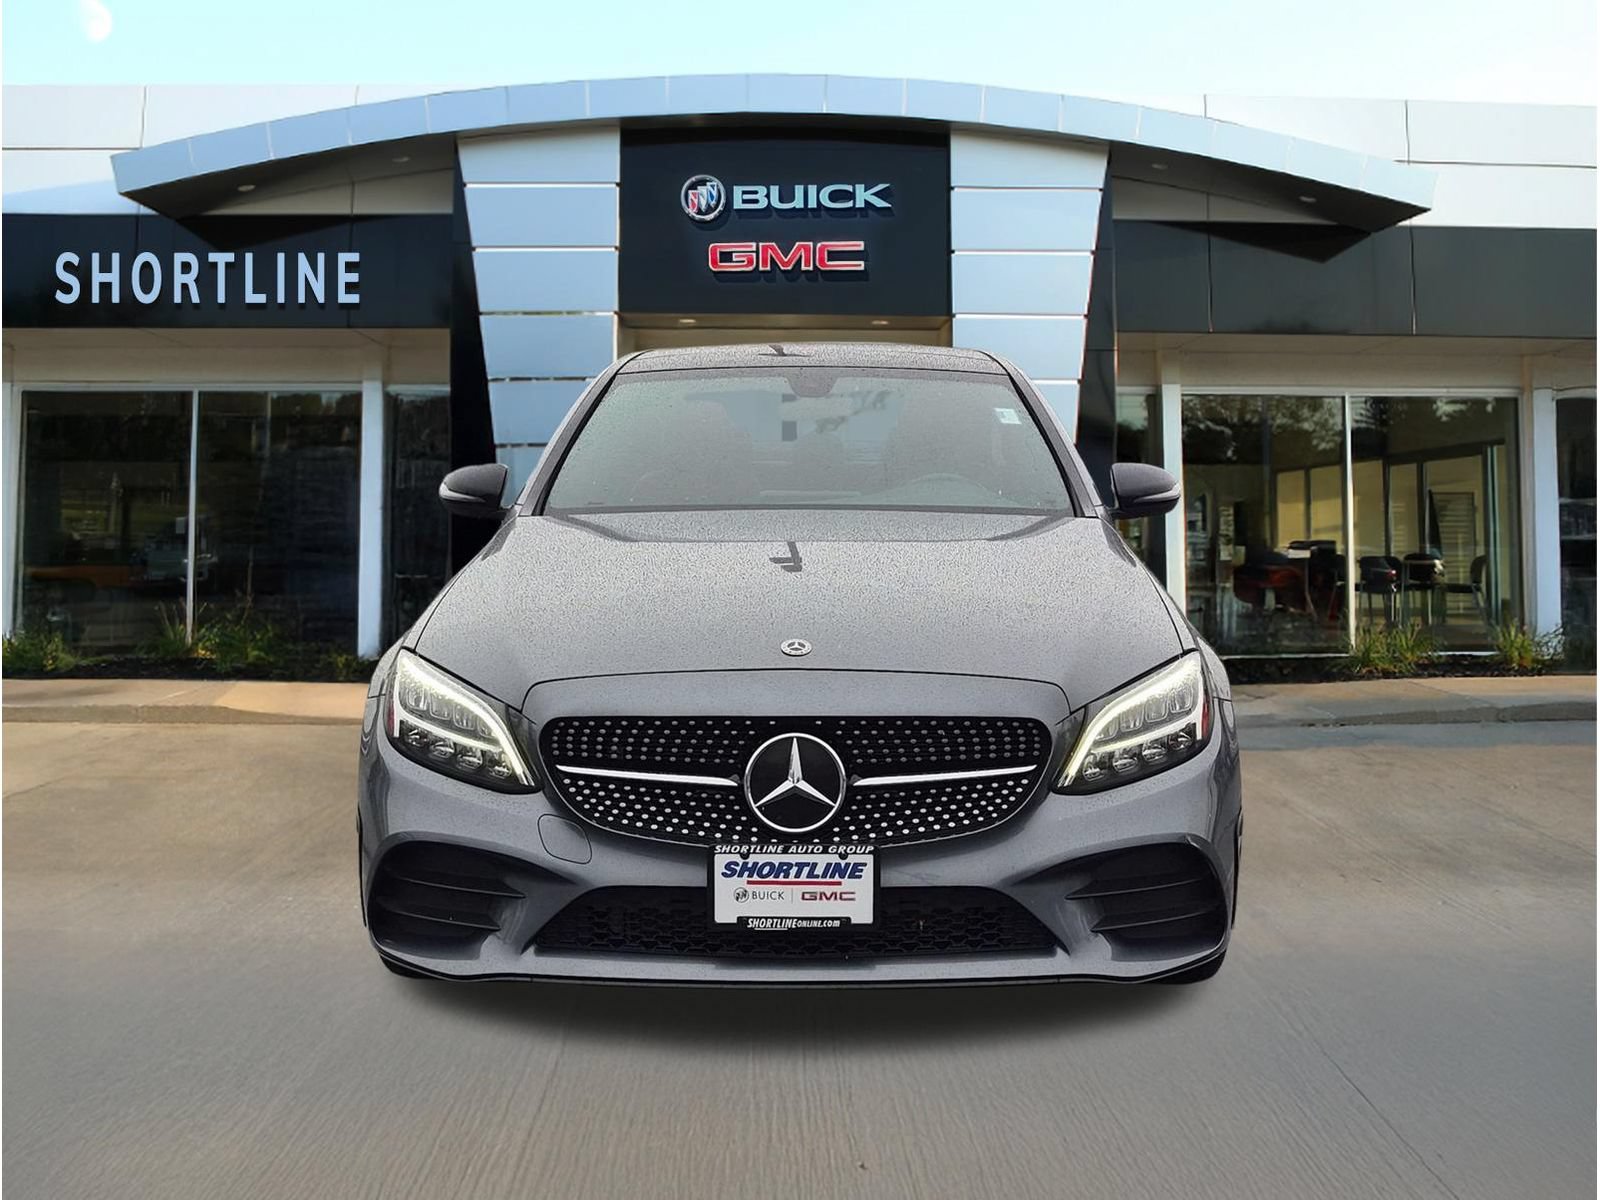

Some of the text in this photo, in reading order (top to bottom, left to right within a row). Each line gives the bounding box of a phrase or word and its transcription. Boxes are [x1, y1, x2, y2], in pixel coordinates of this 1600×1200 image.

[733, 183, 892, 210] BUICK
[708, 241, 865, 272] GMC
[54, 251, 361, 305] SHORTLINE
[714, 844, 874, 854] SHORTLINE AUTO GROUP
[721, 861, 867, 879] SHORTLINE
[752, 890, 857, 901] BUICK GMC
